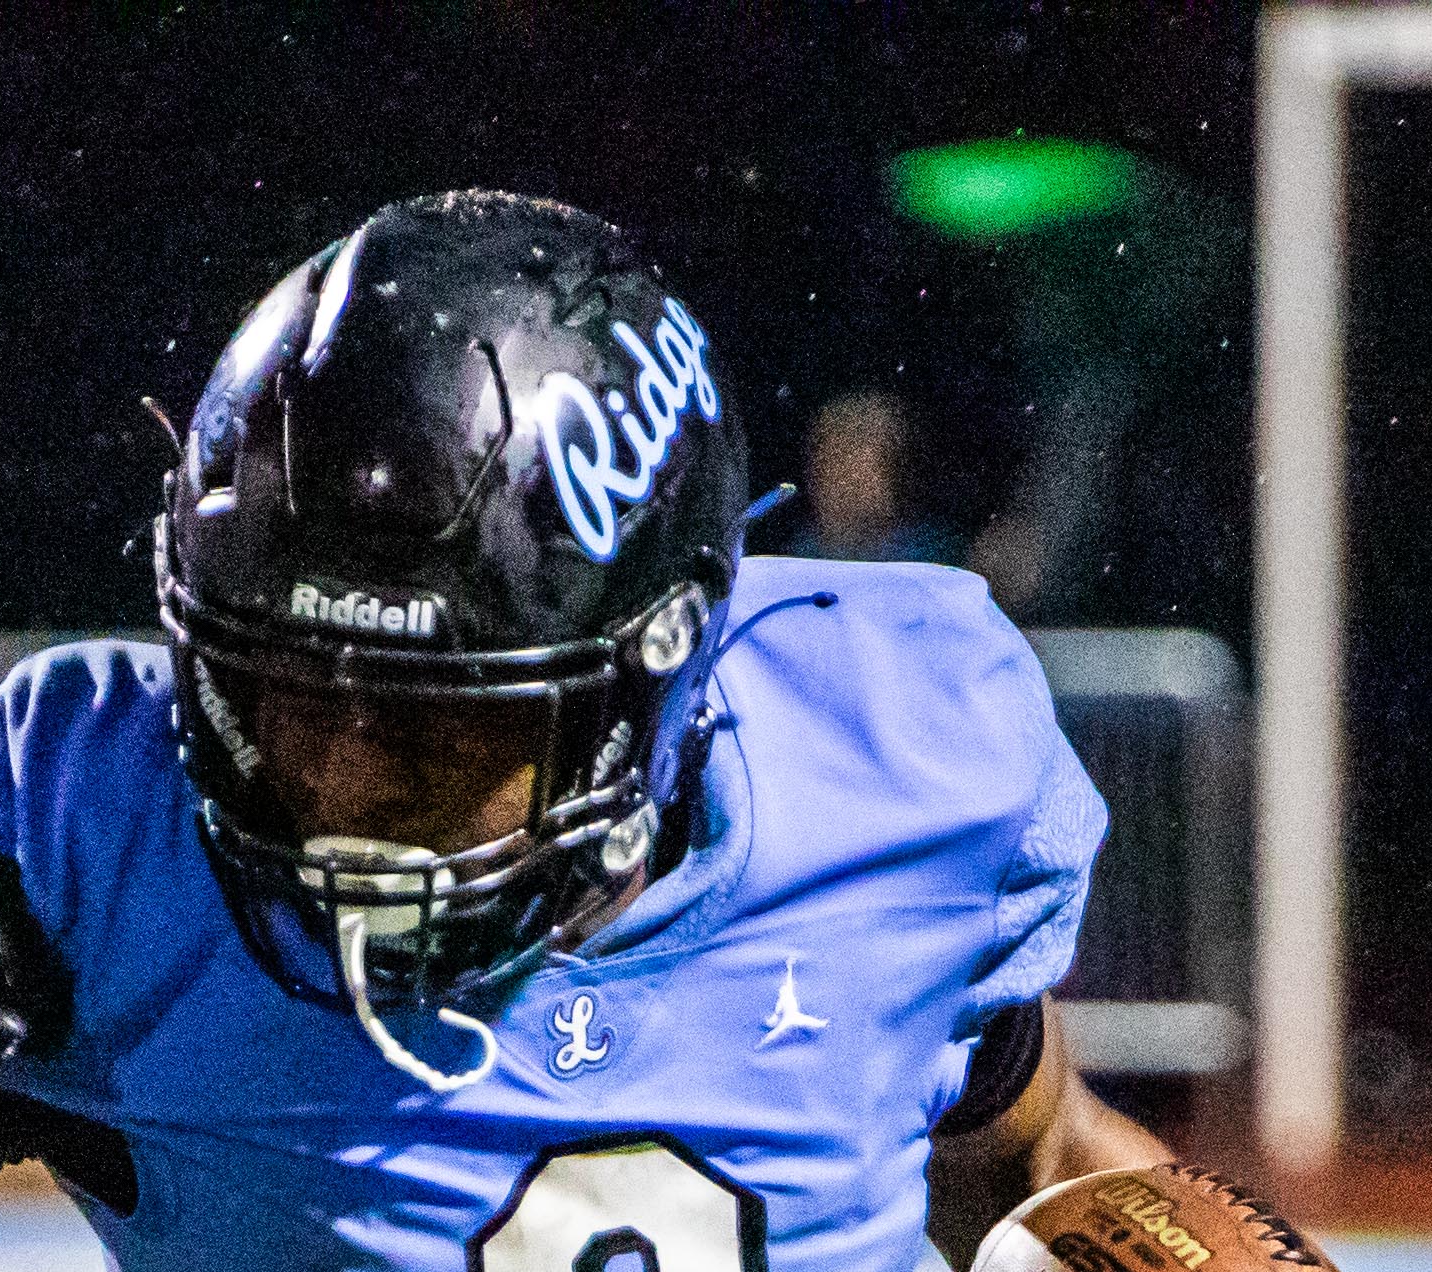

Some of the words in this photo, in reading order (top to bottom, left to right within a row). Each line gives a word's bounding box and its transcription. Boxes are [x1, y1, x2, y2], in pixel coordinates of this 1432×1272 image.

[534, 296, 721, 562] Ridge
[290, 583, 435, 636] Riddell
[550, 992, 612, 1075] L
[1095, 1180, 1213, 1272] Wilson
